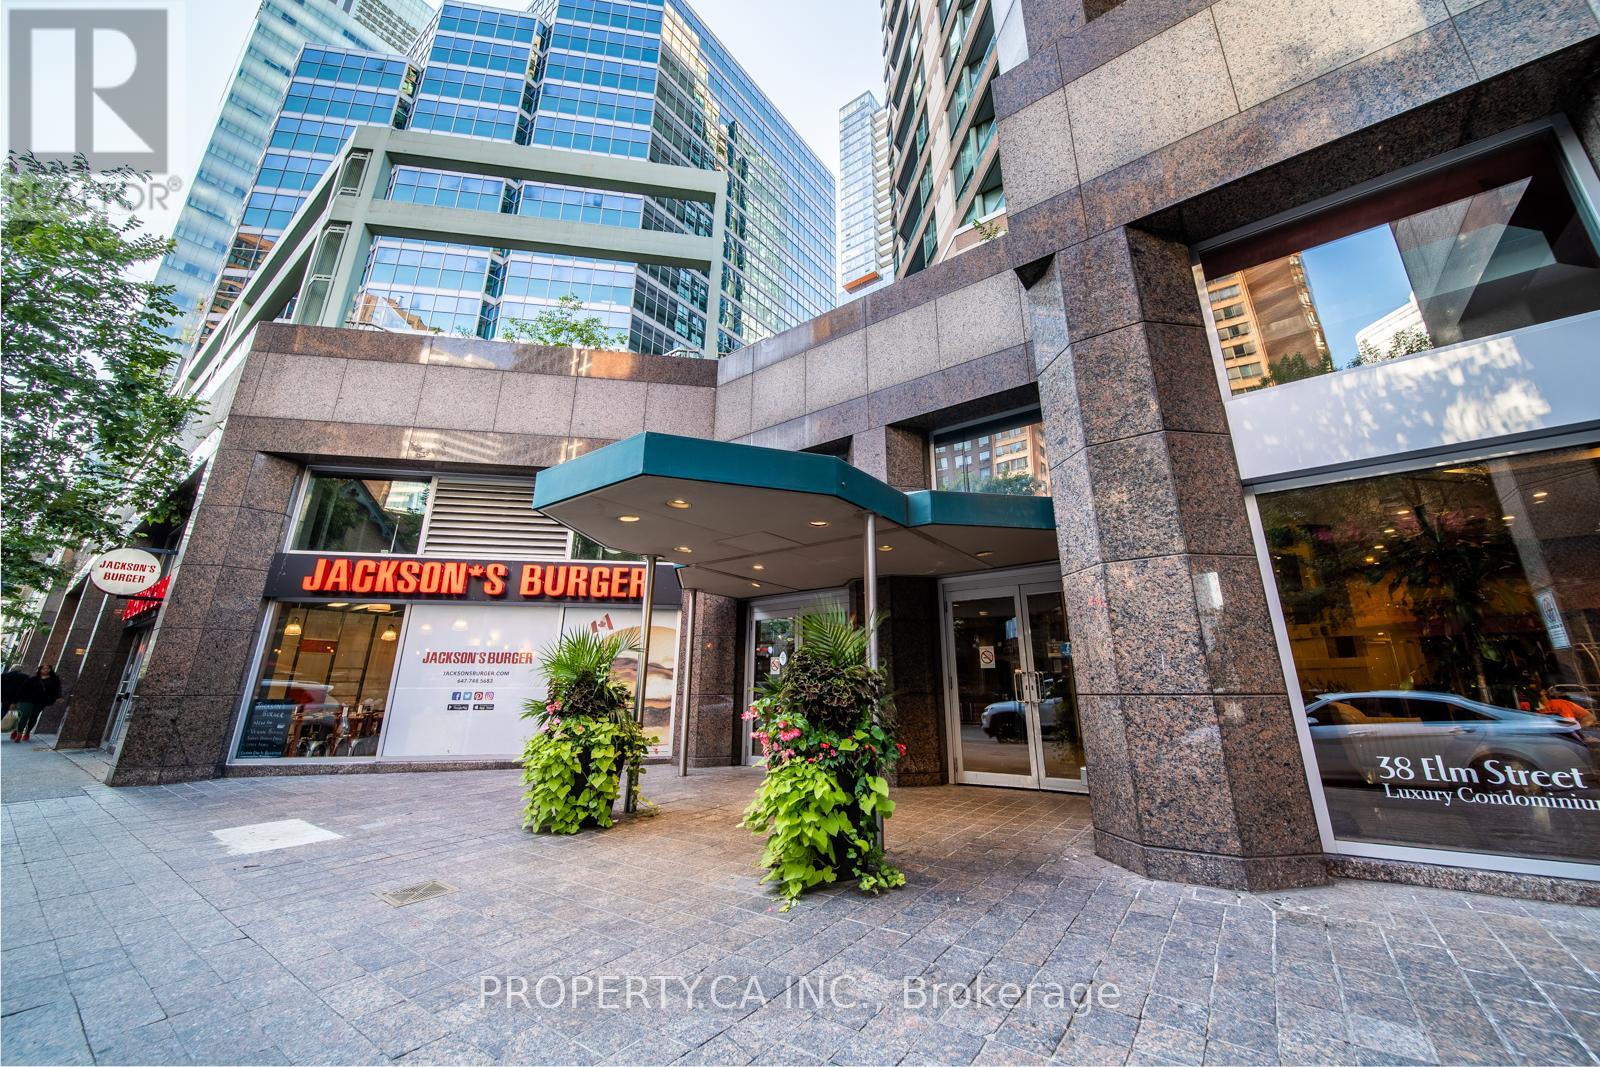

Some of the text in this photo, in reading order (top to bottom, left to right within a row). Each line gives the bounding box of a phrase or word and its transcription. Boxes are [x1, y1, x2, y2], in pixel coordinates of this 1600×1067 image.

[99, 560, 156, 573] JACKSON'S
[103, 572, 146, 583] BURGER
[520, 564, 646, 599] BURGER
[422, 651, 533, 664] JACKSON'S BURGER
[1375, 754, 1588, 789] 38 Elm Street
[1382, 783, 1453, 807] Luxury
